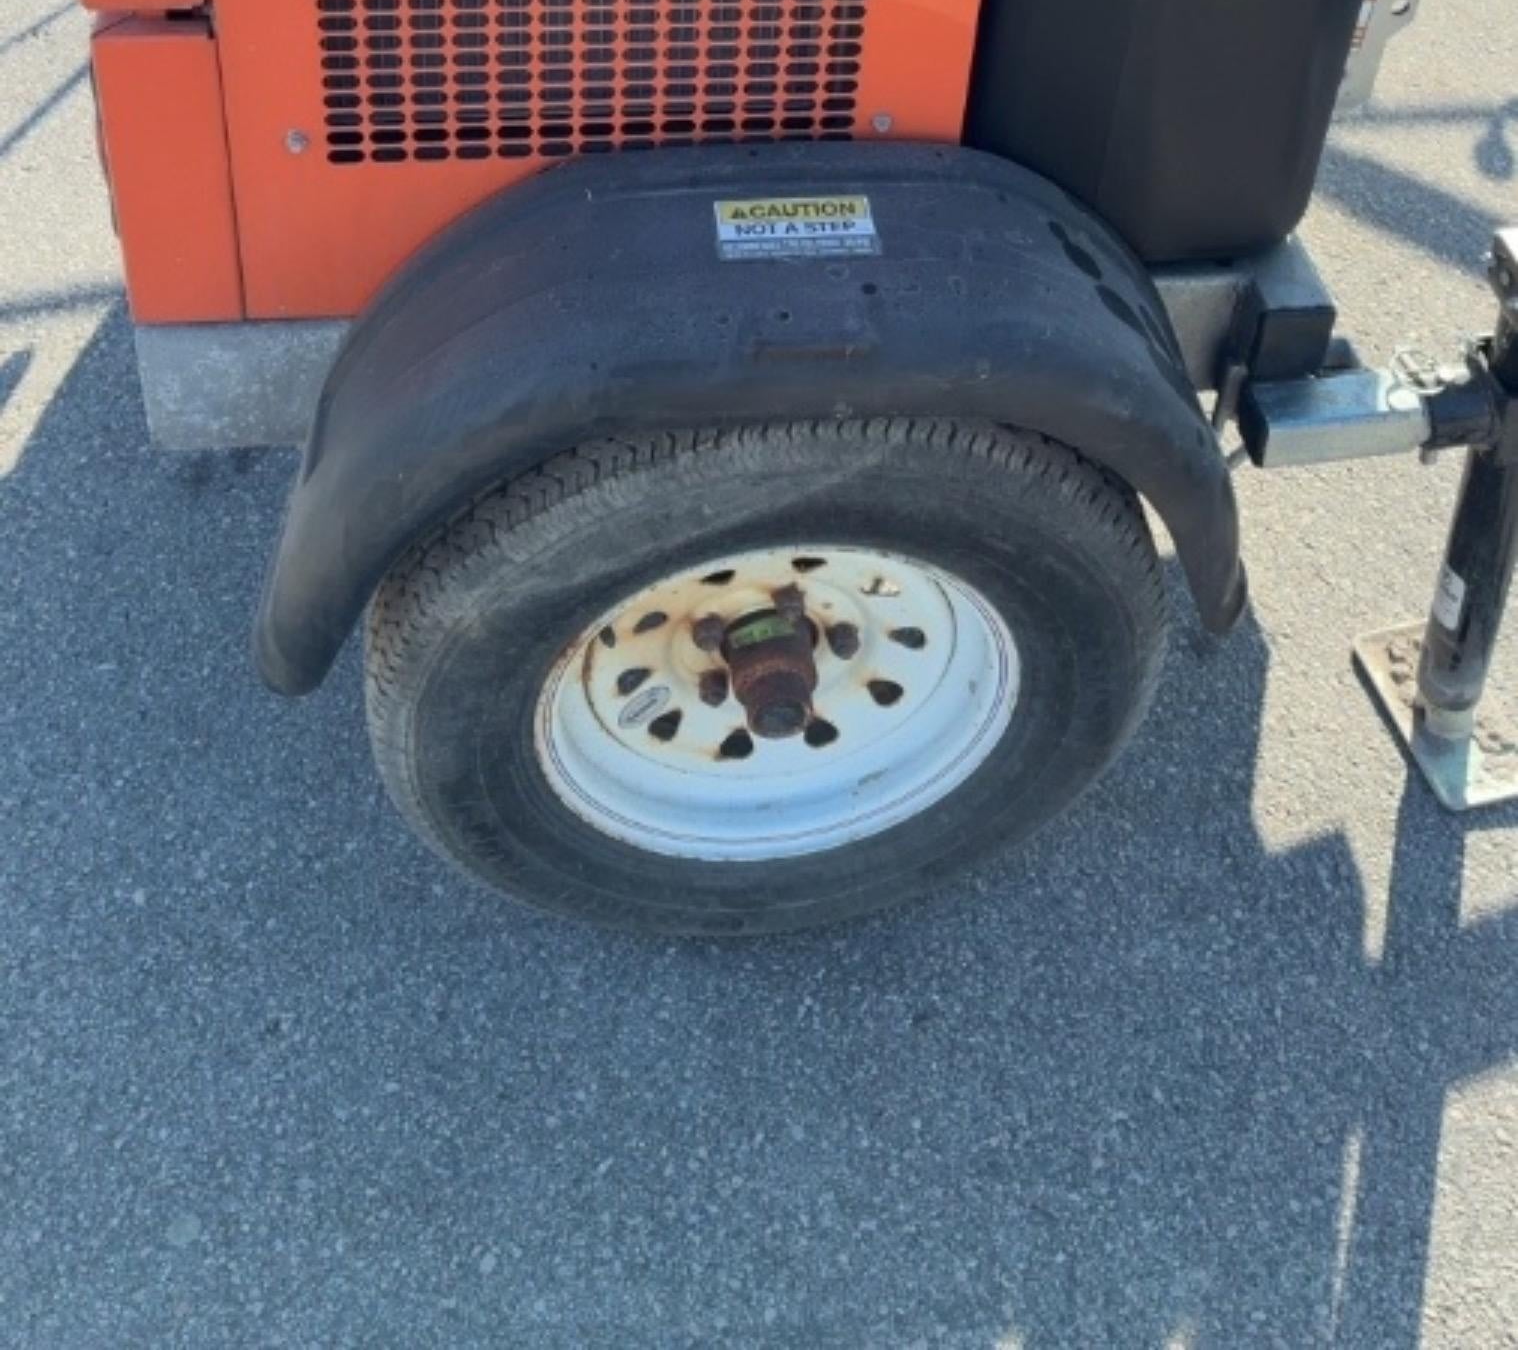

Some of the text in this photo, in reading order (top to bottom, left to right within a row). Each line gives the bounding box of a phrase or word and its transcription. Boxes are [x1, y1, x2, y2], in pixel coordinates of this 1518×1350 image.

[750, 201, 856, 218] CAUTION
[735, 220, 856, 236] NOT A STEP
